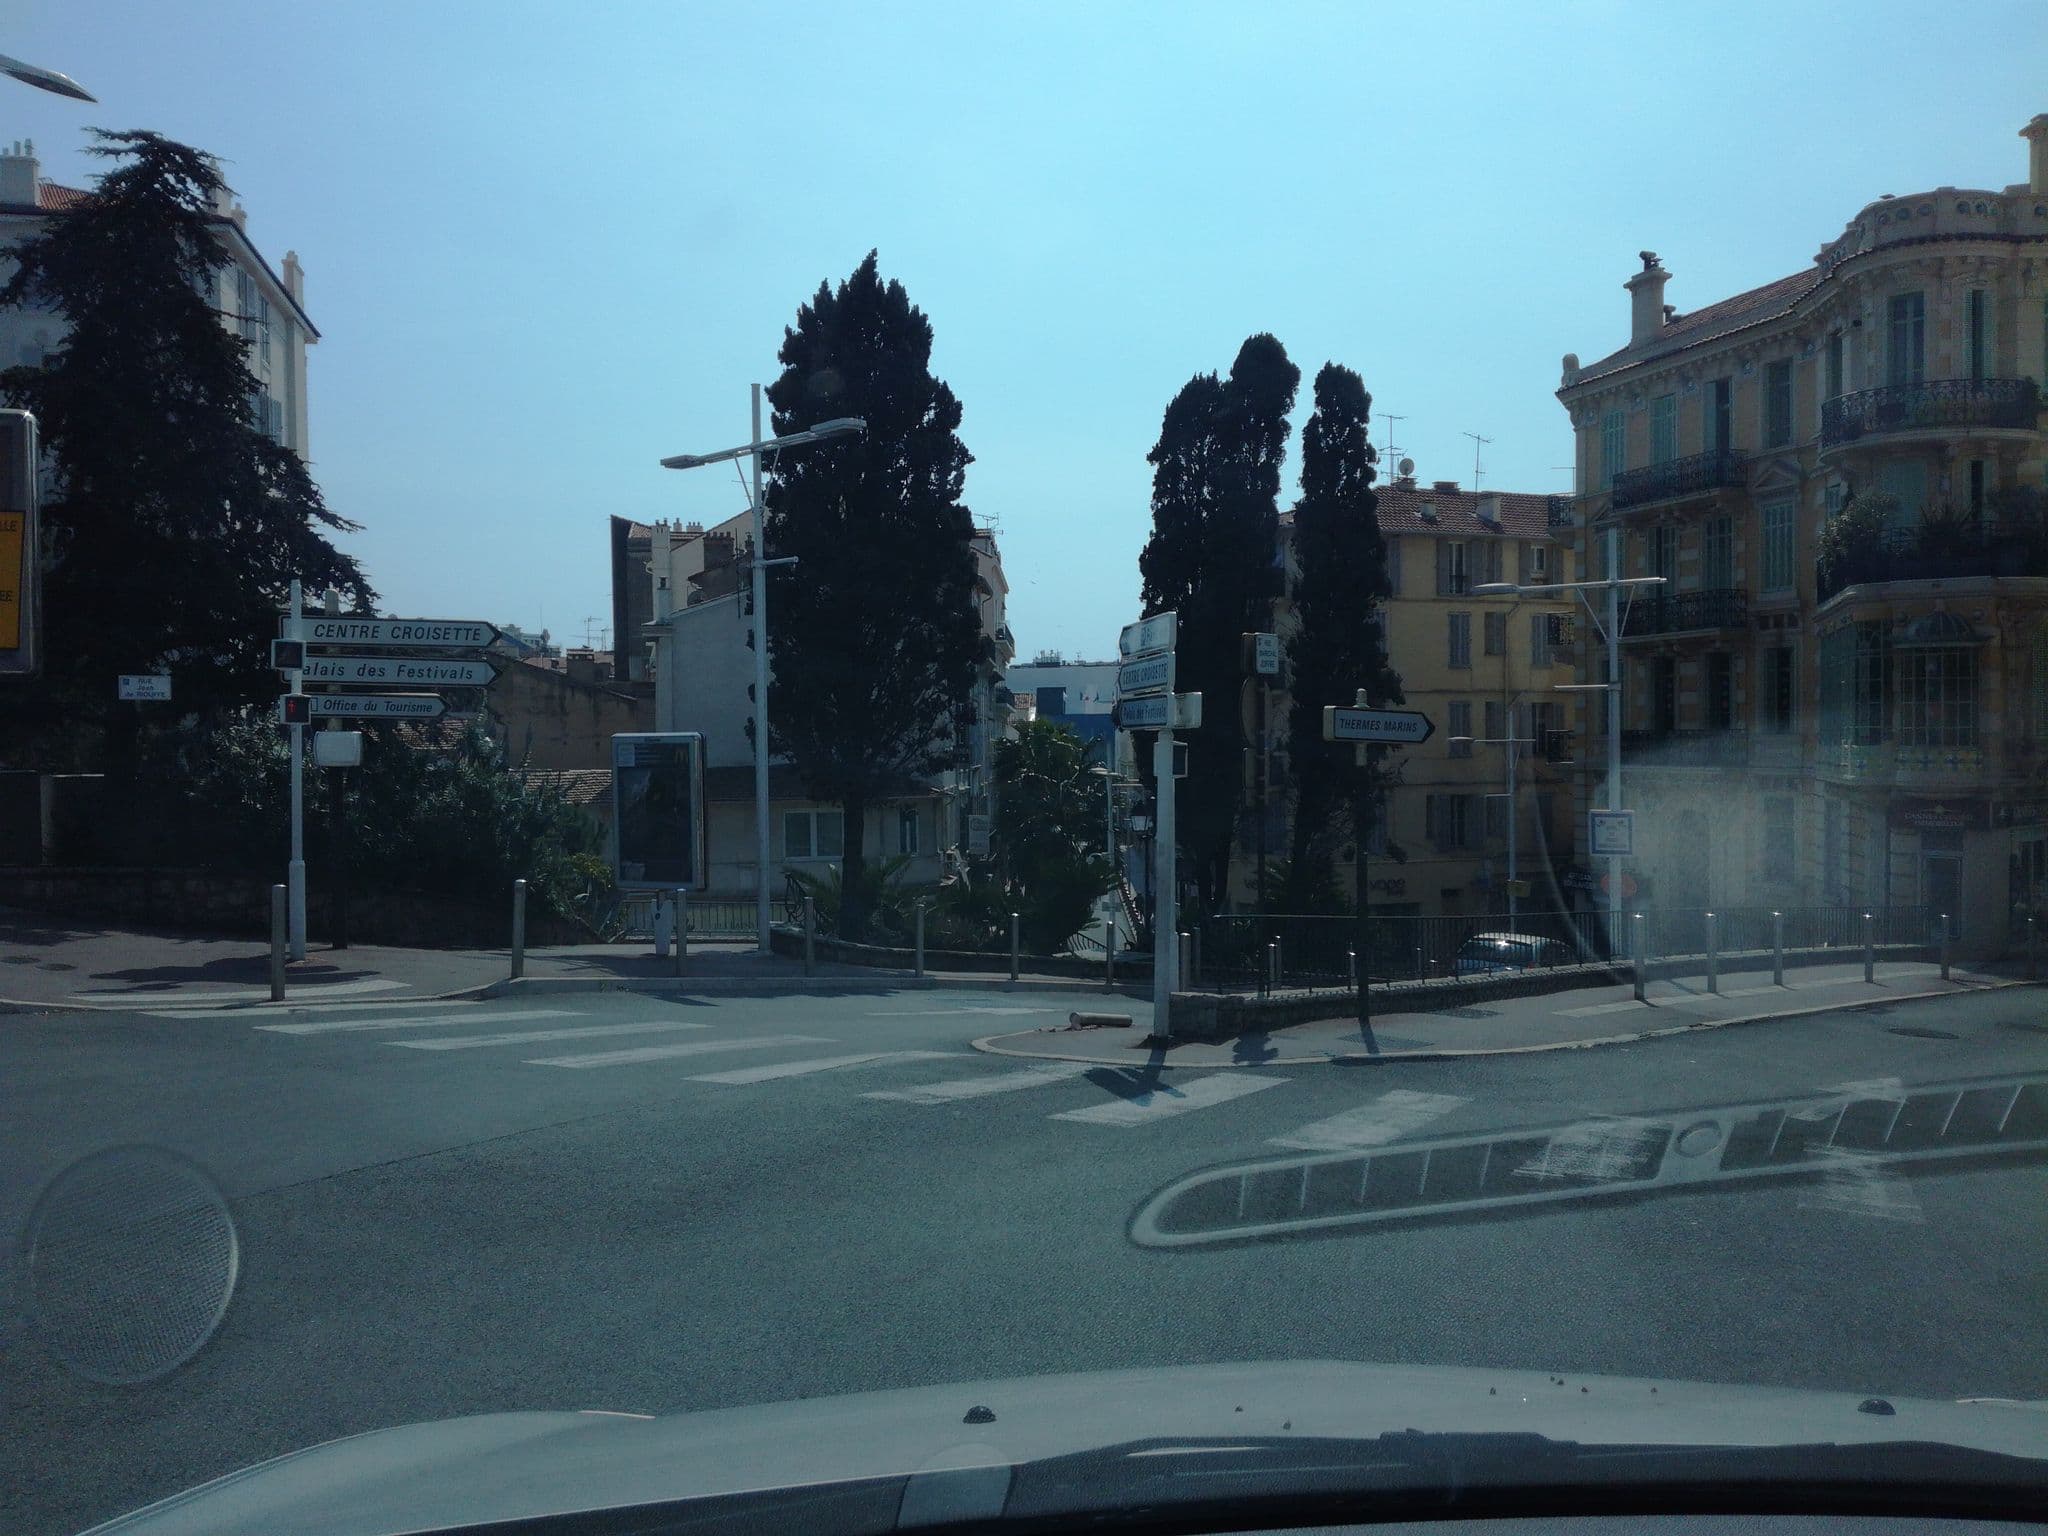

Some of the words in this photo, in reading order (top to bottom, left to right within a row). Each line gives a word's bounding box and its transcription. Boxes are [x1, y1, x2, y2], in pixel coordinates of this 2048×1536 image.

[314, 624, 380, 639] CENTRE
[390, 626, 481, 641] CROISETTE
[302, 662, 345, 677] alais
[357, 663, 386, 678] des
[397, 665, 473, 680] Festivals
[323, 699, 357, 712] Office
[364, 700, 377, 712] du
[384, 701, 433, 713] Tourisme
[1340, 718, 1380, 731] THERMES
[1383, 720, 1417, 733] MARINS
